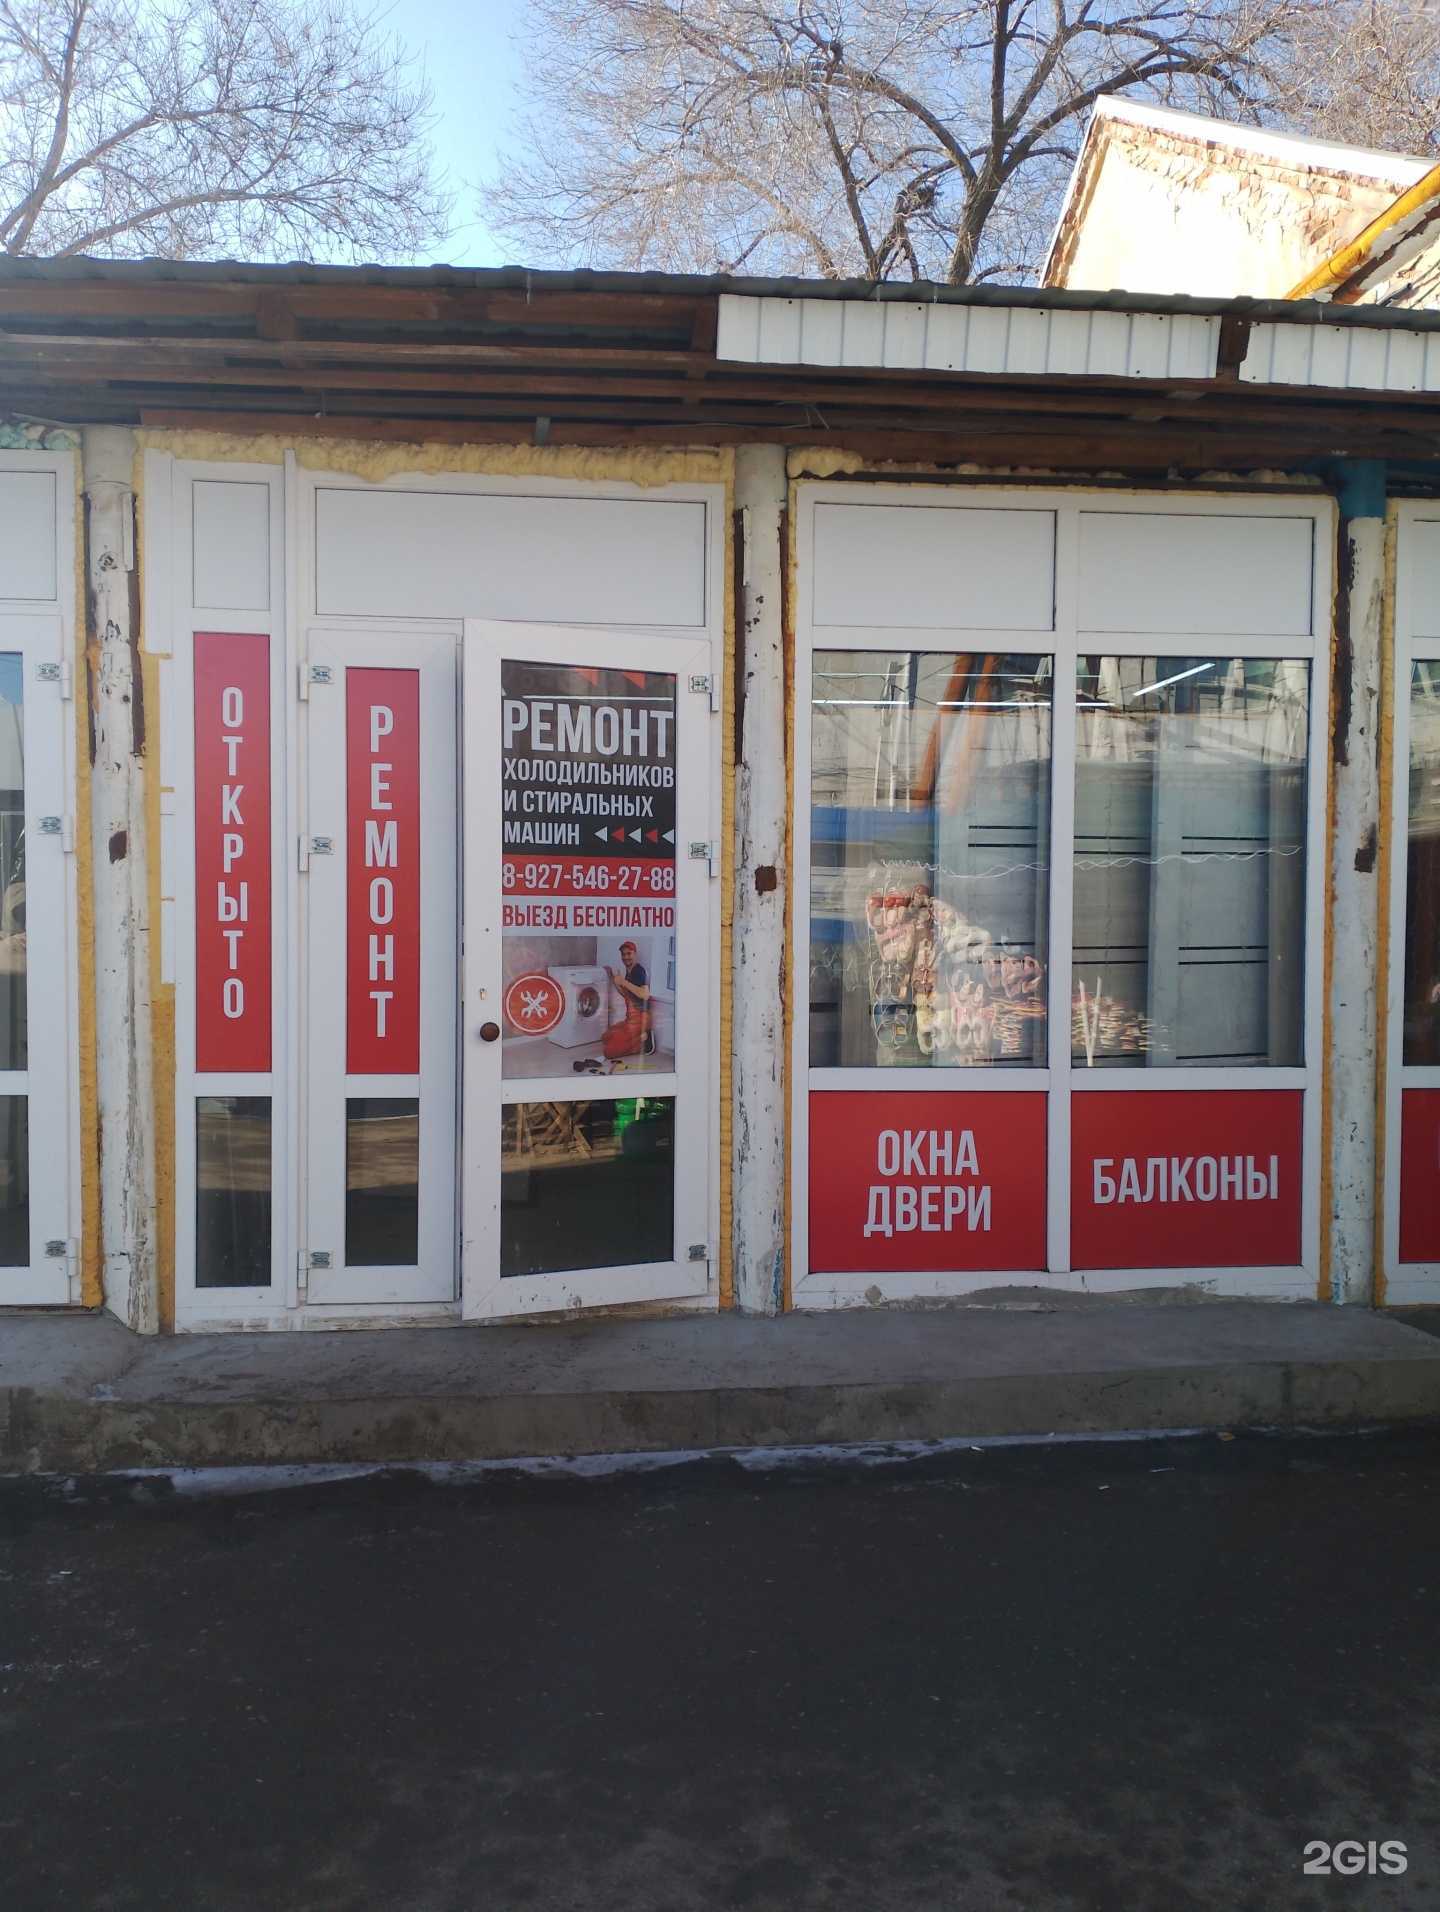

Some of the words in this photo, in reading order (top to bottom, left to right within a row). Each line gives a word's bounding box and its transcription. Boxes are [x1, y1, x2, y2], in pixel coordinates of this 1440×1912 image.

[503, 700, 674, 758] РЕМОНТ
[503, 757, 674, 788] ХОЛОДИЛЬНИКОВ
[503, 789, 517, 812] И
[522, 791, 654, 818] СТИРАЛЬНЫХ
[217, 686, 248, 1019] ОТКРЫТО
[503, 821, 580, 845] МАШИН
[365, 705, 398, 1038] РЕМОНТ
[502, 862, 674, 891] 8-927-546-27-88
[502, 904, 568, 929] ВЫЕЗД
[573, 905, 674, 929] БЕСПЛАТНО
[877, 1129, 980, 1177] ОКНА
[1093, 1154, 1279, 1204] БАЛКОНЫ
[863, 1185, 992, 1238] ДВЕРИ
